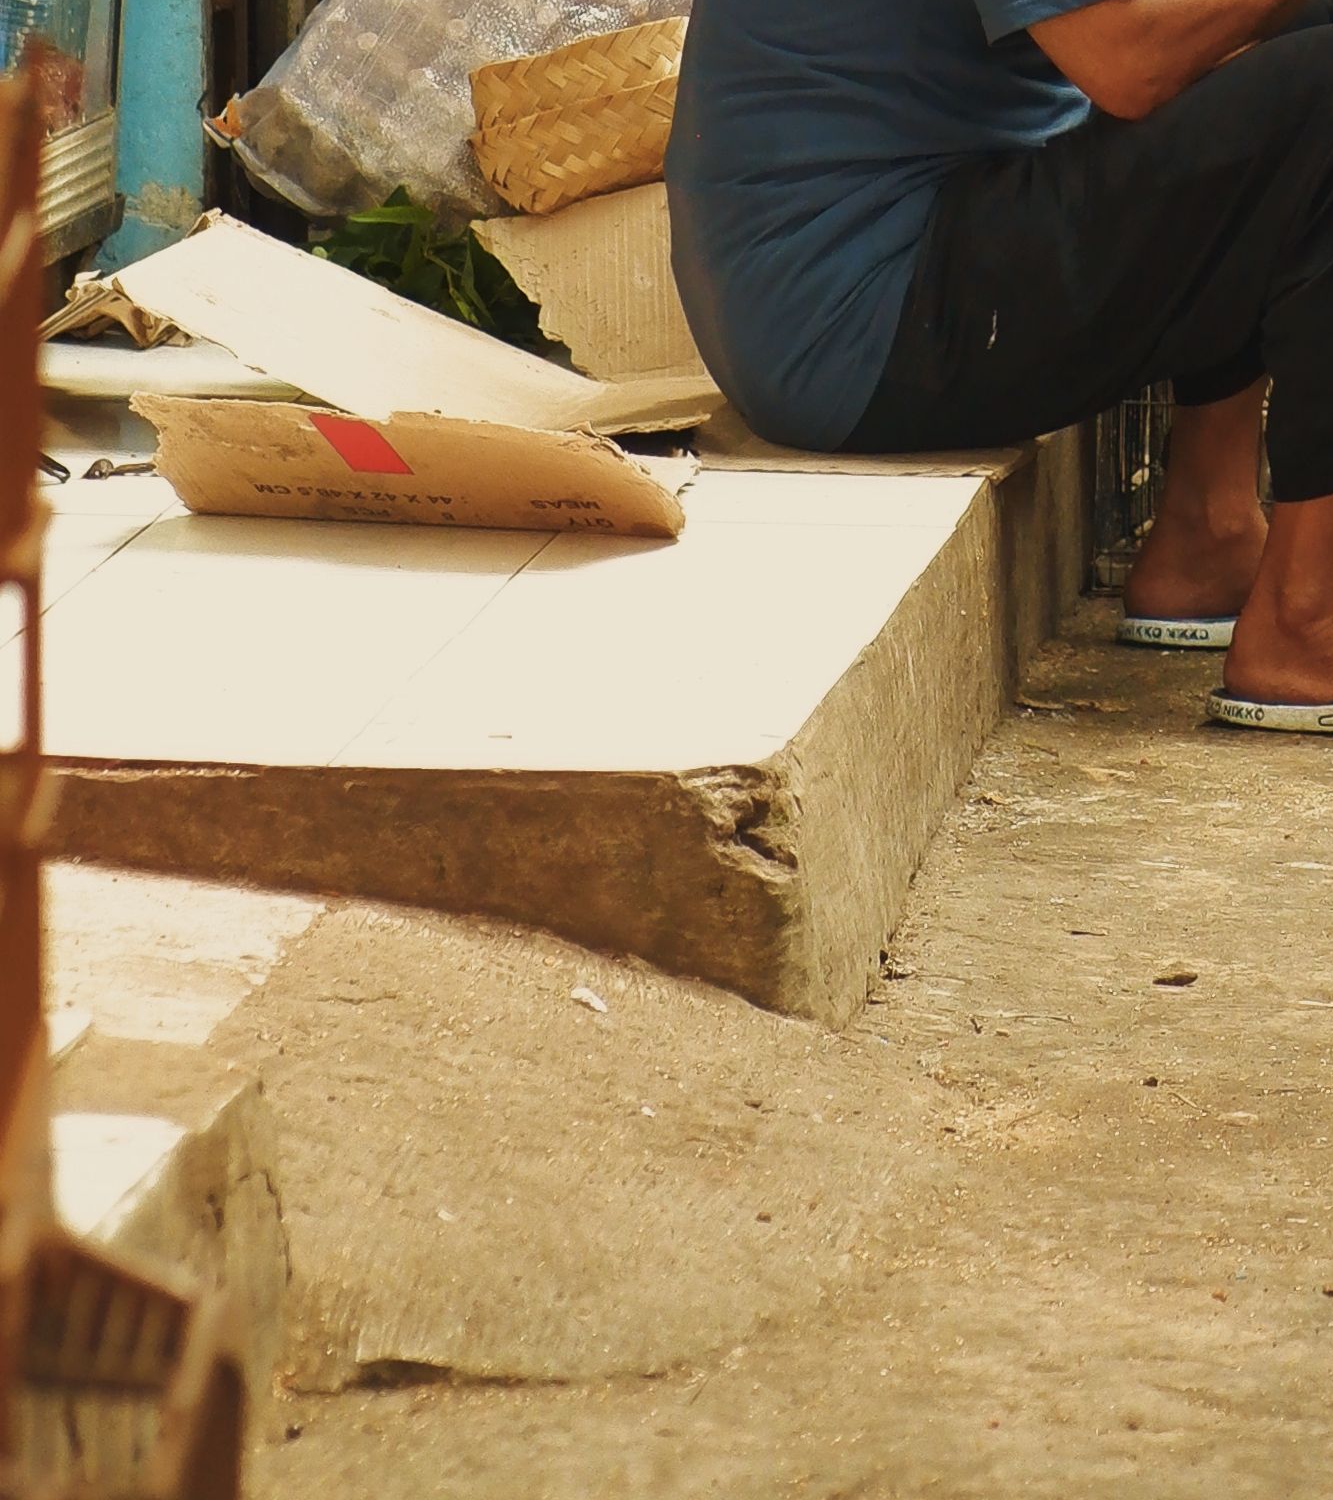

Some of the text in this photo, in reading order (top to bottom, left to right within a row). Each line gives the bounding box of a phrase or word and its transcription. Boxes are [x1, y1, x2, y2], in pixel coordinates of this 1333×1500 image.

[253, 482, 290, 495] CM
[530, 499, 601, 510] MEAS
[1223, 703, 1265, 722] NIKKO
